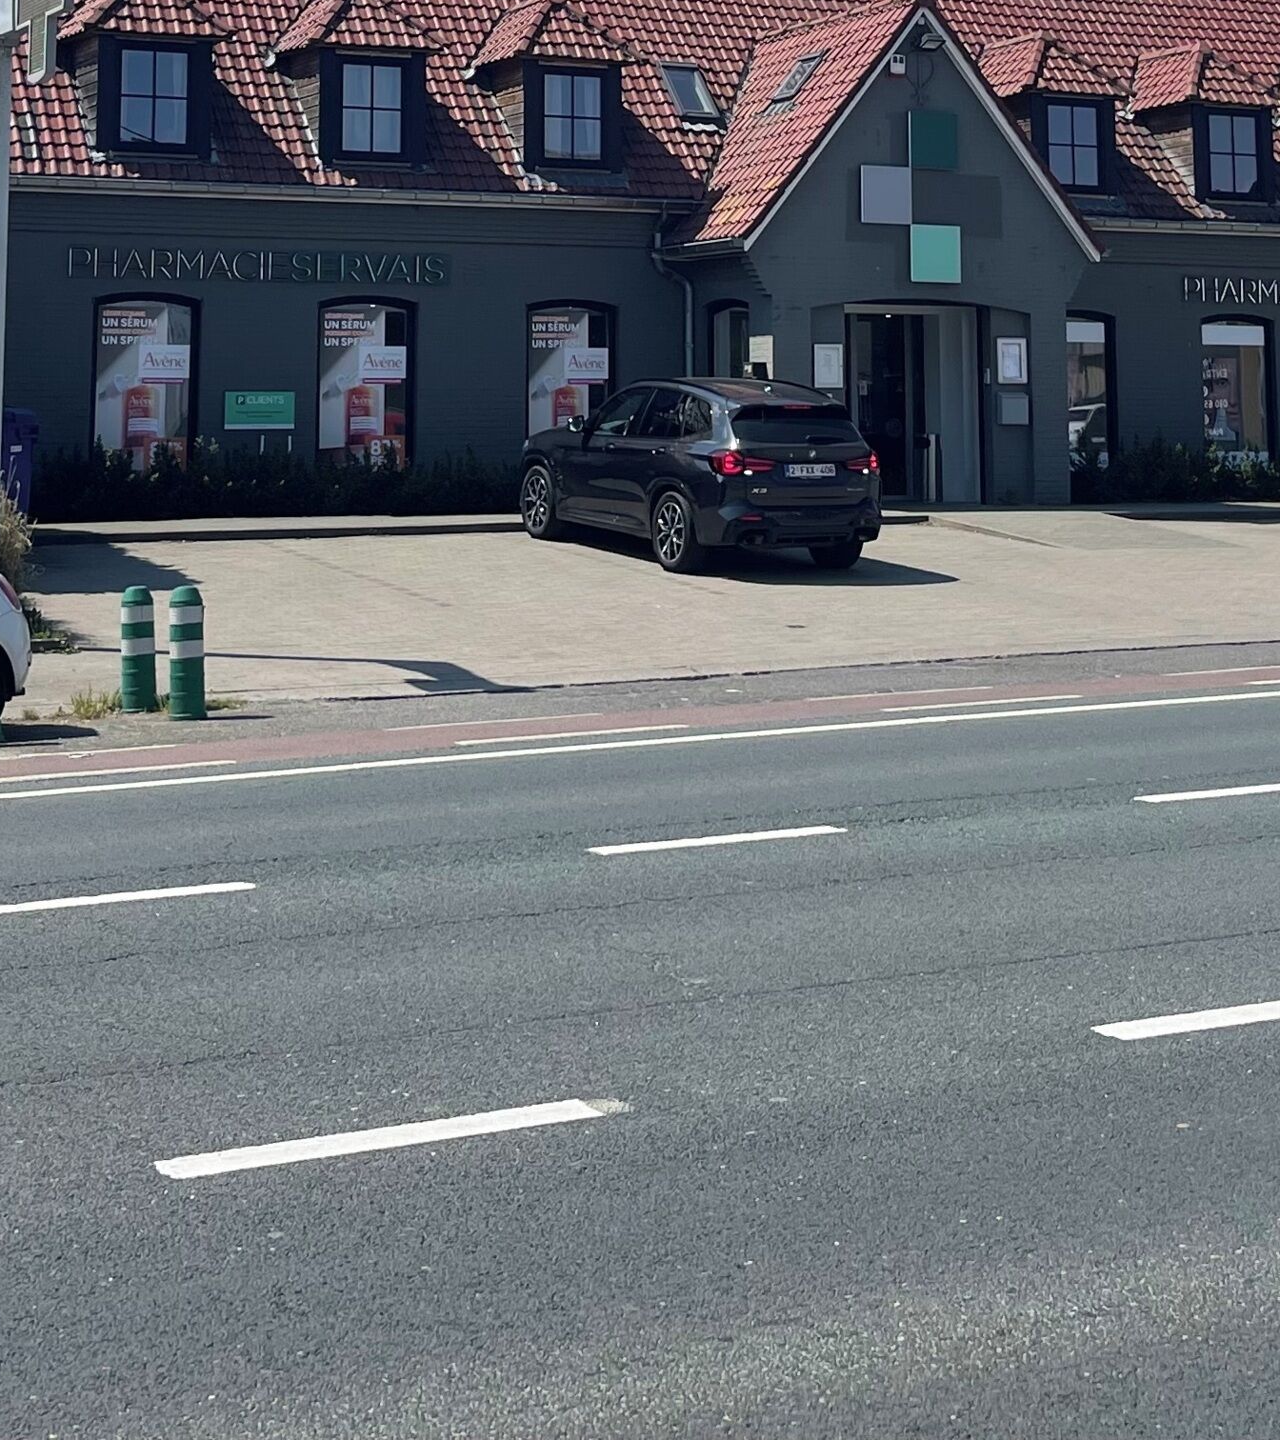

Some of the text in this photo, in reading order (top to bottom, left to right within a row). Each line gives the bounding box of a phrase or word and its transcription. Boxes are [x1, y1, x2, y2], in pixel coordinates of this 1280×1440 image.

[101, 315, 158, 328] UN SÉRUM
[324, 320, 340, 329] UN
[532, 323, 545, 332] UN
[101, 335, 118, 345] UN
[324, 337, 340, 347] UN
[531, 339, 545, 349] UN
[142, 351, 186, 368] Avène
[363, 353, 402, 368] Avène
